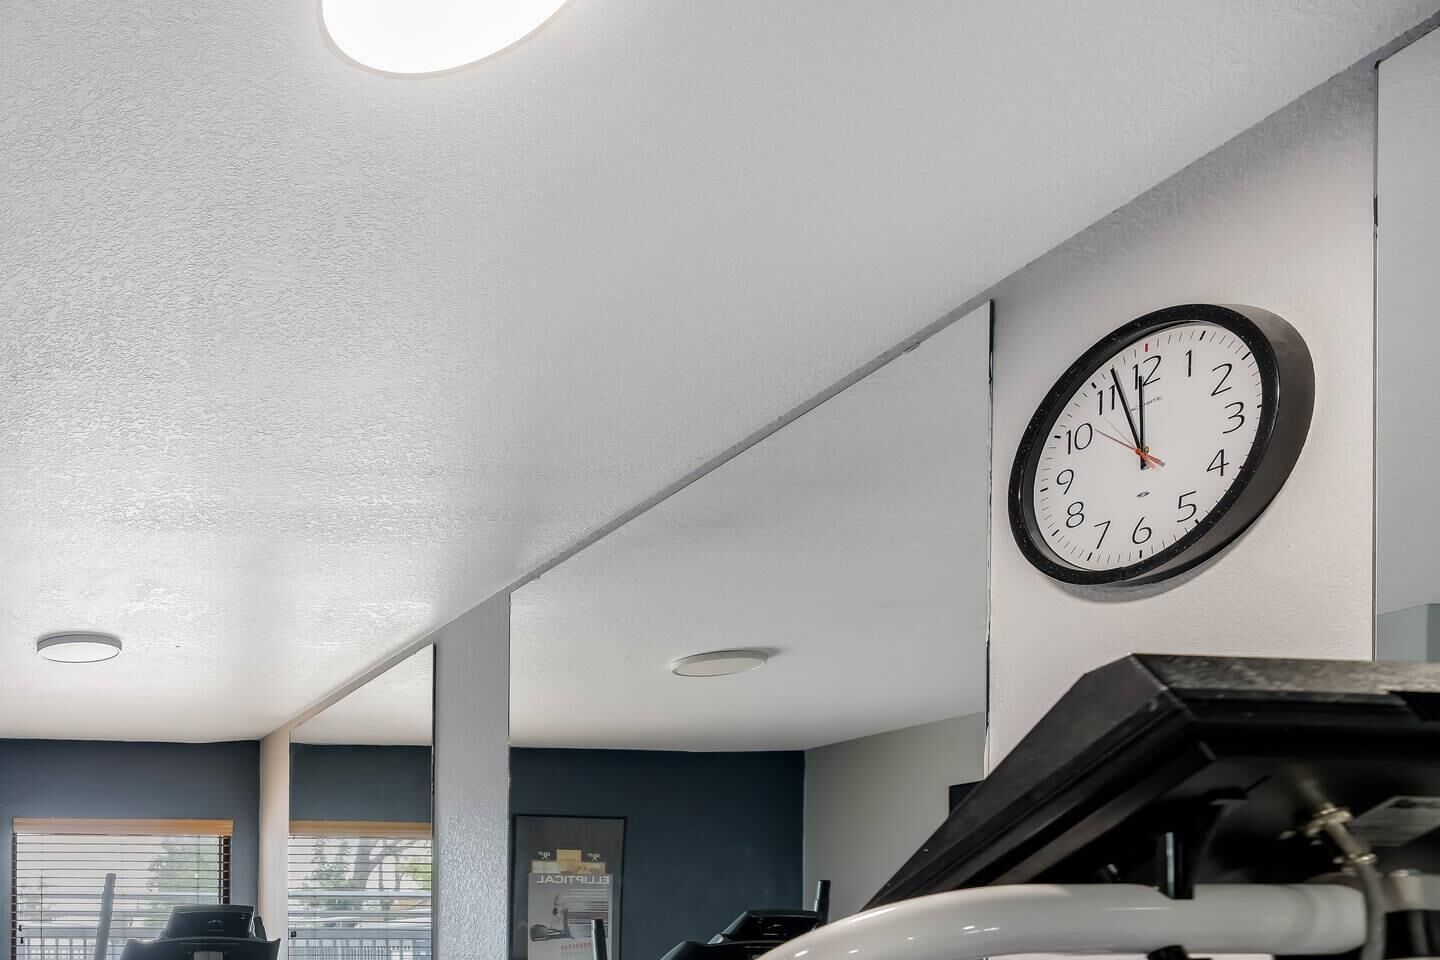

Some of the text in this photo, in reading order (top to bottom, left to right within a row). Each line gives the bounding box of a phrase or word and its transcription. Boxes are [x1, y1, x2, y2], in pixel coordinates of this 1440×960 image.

[1132, 354, 1162, 391] 12
[1185, 349, 1193, 378] 1
[1210, 363, 1233, 398] 2
[1097, 384, 1115, 416] 11
[1222, 401, 1246, 434] 3
[1065, 422, 1094, 455] 10
[1206, 448, 1230, 477] 4
[1056, 468, 1075, 496] 9
[1065, 501, 1085, 529] 8
[1176, 490, 1198, 523] 5
[1093, 520, 1111, 550] 7
[1131, 516, 1152, 545] 6
